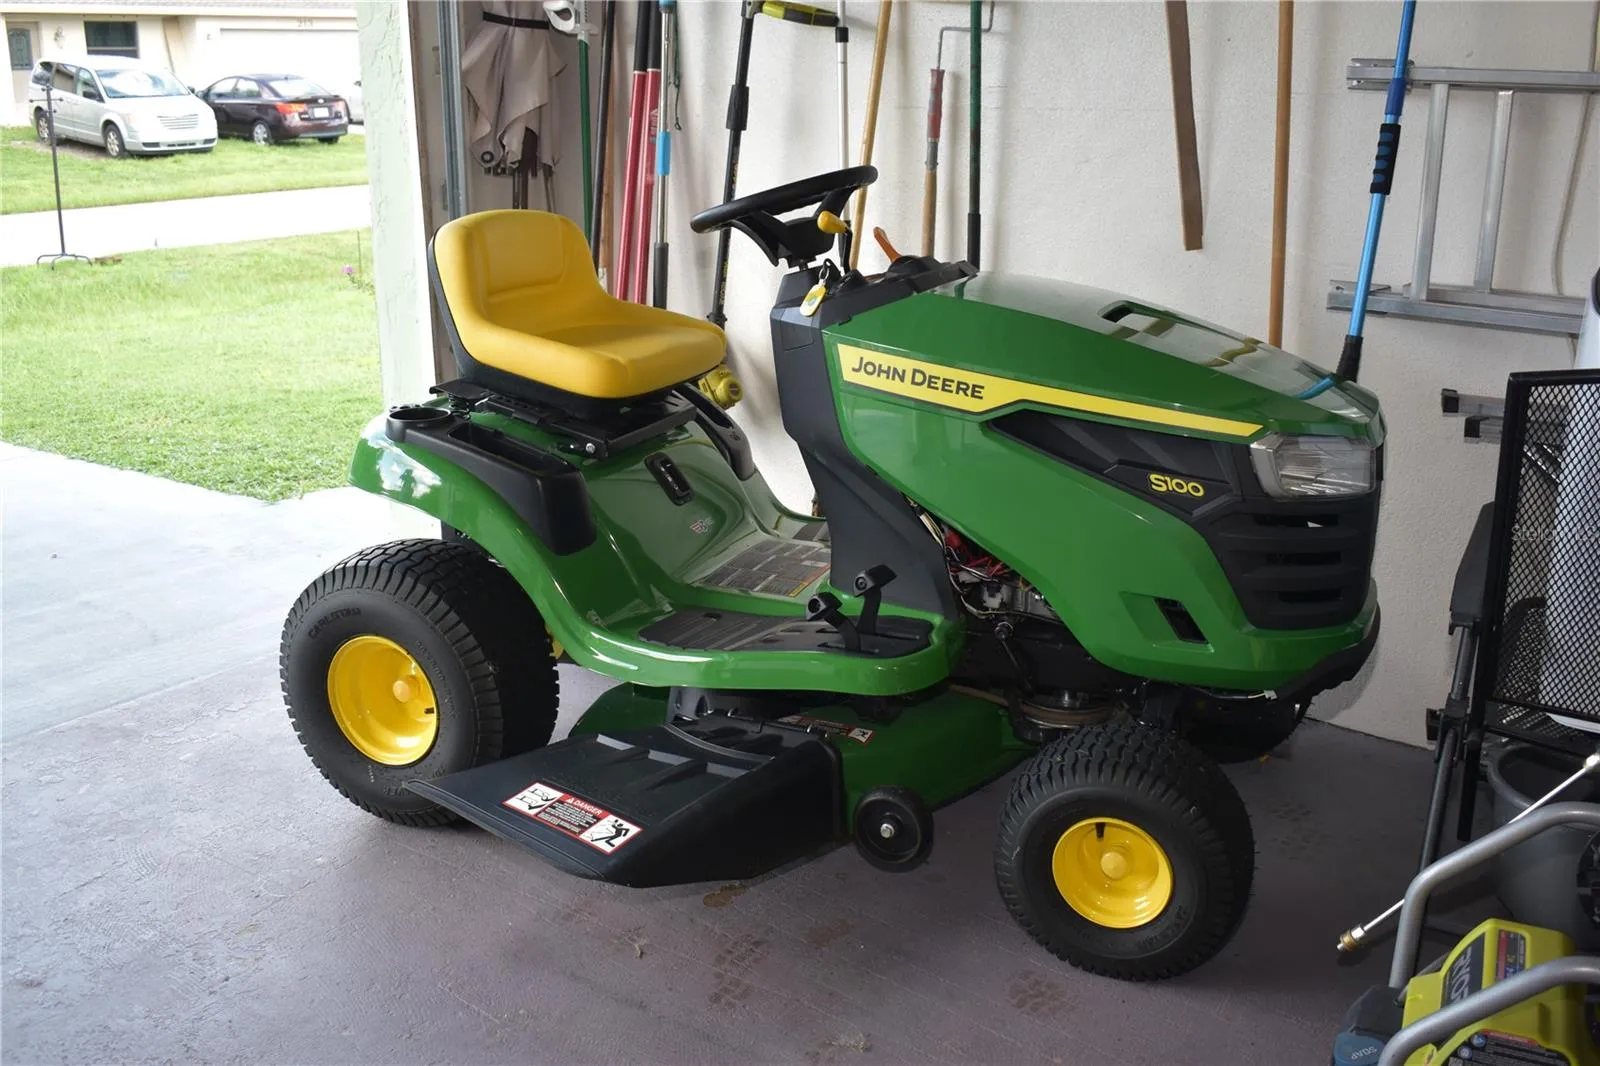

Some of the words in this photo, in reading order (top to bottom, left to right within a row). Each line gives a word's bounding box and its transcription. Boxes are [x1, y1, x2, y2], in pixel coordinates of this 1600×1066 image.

[851, 356, 906, 383] JOHN
[911, 368, 985, 400] DEERE
[1149, 473, 1204, 497] S100
[573, 798, 603, 816] DANGER
